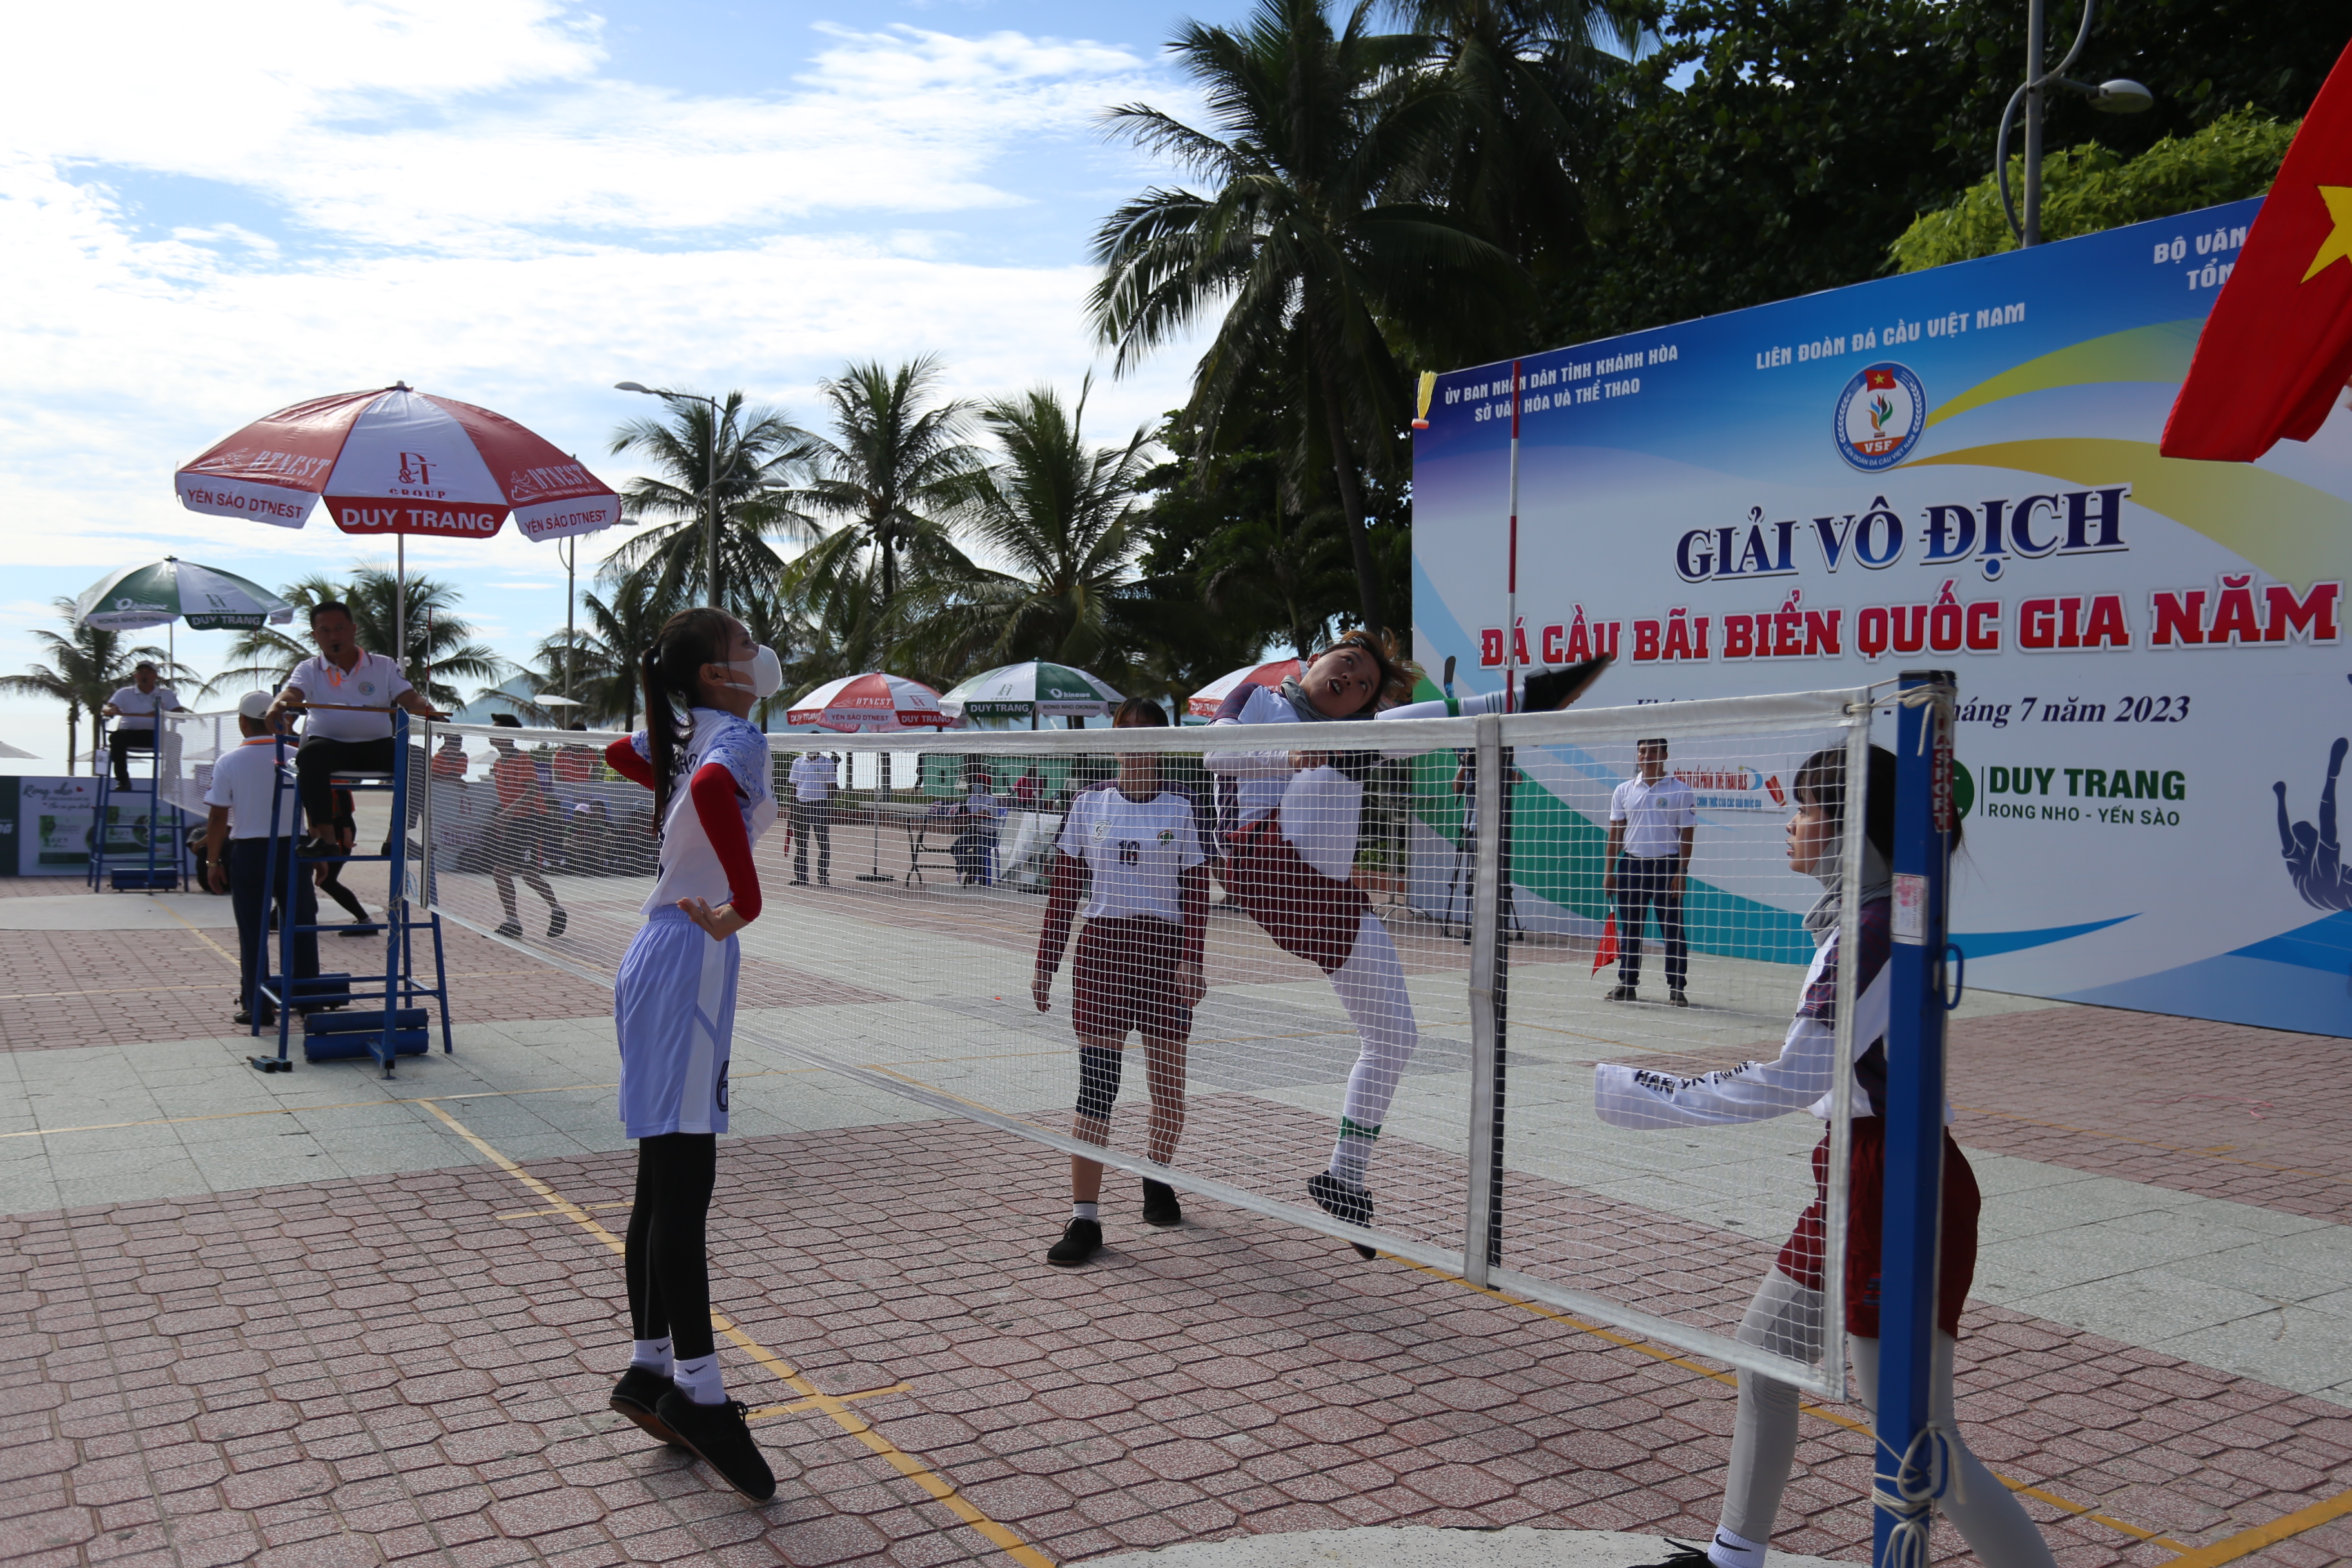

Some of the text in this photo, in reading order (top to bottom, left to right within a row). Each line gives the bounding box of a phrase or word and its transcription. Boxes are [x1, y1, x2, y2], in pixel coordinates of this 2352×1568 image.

[2153, 226, 2247, 264] BỘ VĂN
[2186, 258, 2235, 291] TỔN
[1756, 302, 2025, 370] LIÊN ĐOÀN ĐÁ CẦU VIỆT NAM
[1464, 384, 1489, 402] BAN
[1531, 369, 1557, 389] DÂN
[1561, 362, 1591, 382] TỈNH
[1596, 352, 1644, 375] KHÁNH
[1649, 344, 1678, 365] HÒA
[1475, 378, 1640, 422] SỞ VĂ HÓA VÀ THỂ THAO
[1864, 440, 1893, 453] VSF
[1903, 434, 1916, 450] NAM
[250, 450, 332, 478] DTNEST
[527, 464, 591, 489] DTNEST
[389, 488, 446, 499] GROUP
[249, 498, 304, 518] DTNEST
[342, 509, 495, 531] DUY TRANG
[546, 513, 568, 530] SÀO
[569, 510, 607, 525] DTNEST
[1676, 487, 2129, 580] GIẢI VÔ ĐỊCH
[193, 616, 260, 626] DUY TRANG
[1481, 574, 2340, 665] ĐÁ CẦU BÃI BIỂN QUỐC GIA NĂM
[856, 698, 892, 706] DTNEST
[970, 704, 992, 712] DUY
[995, 703, 1029, 712] TRANG
[1954, 696, 2012, 729] áng
[2020, 697, 2038, 722] 7
[2041, 696, 2106, 722] năm
[2113, 696, 2191, 723] 2023
[1990, 767, 2055, 795] DUY
[2063, 769, 2185, 800] TRANG
[1988, 803, 2035, 819] RONG
[2042, 806, 2079, 821] NHO
[2098, 804, 2133, 824] YẾN
[2140, 805, 2180, 826] SÀO
